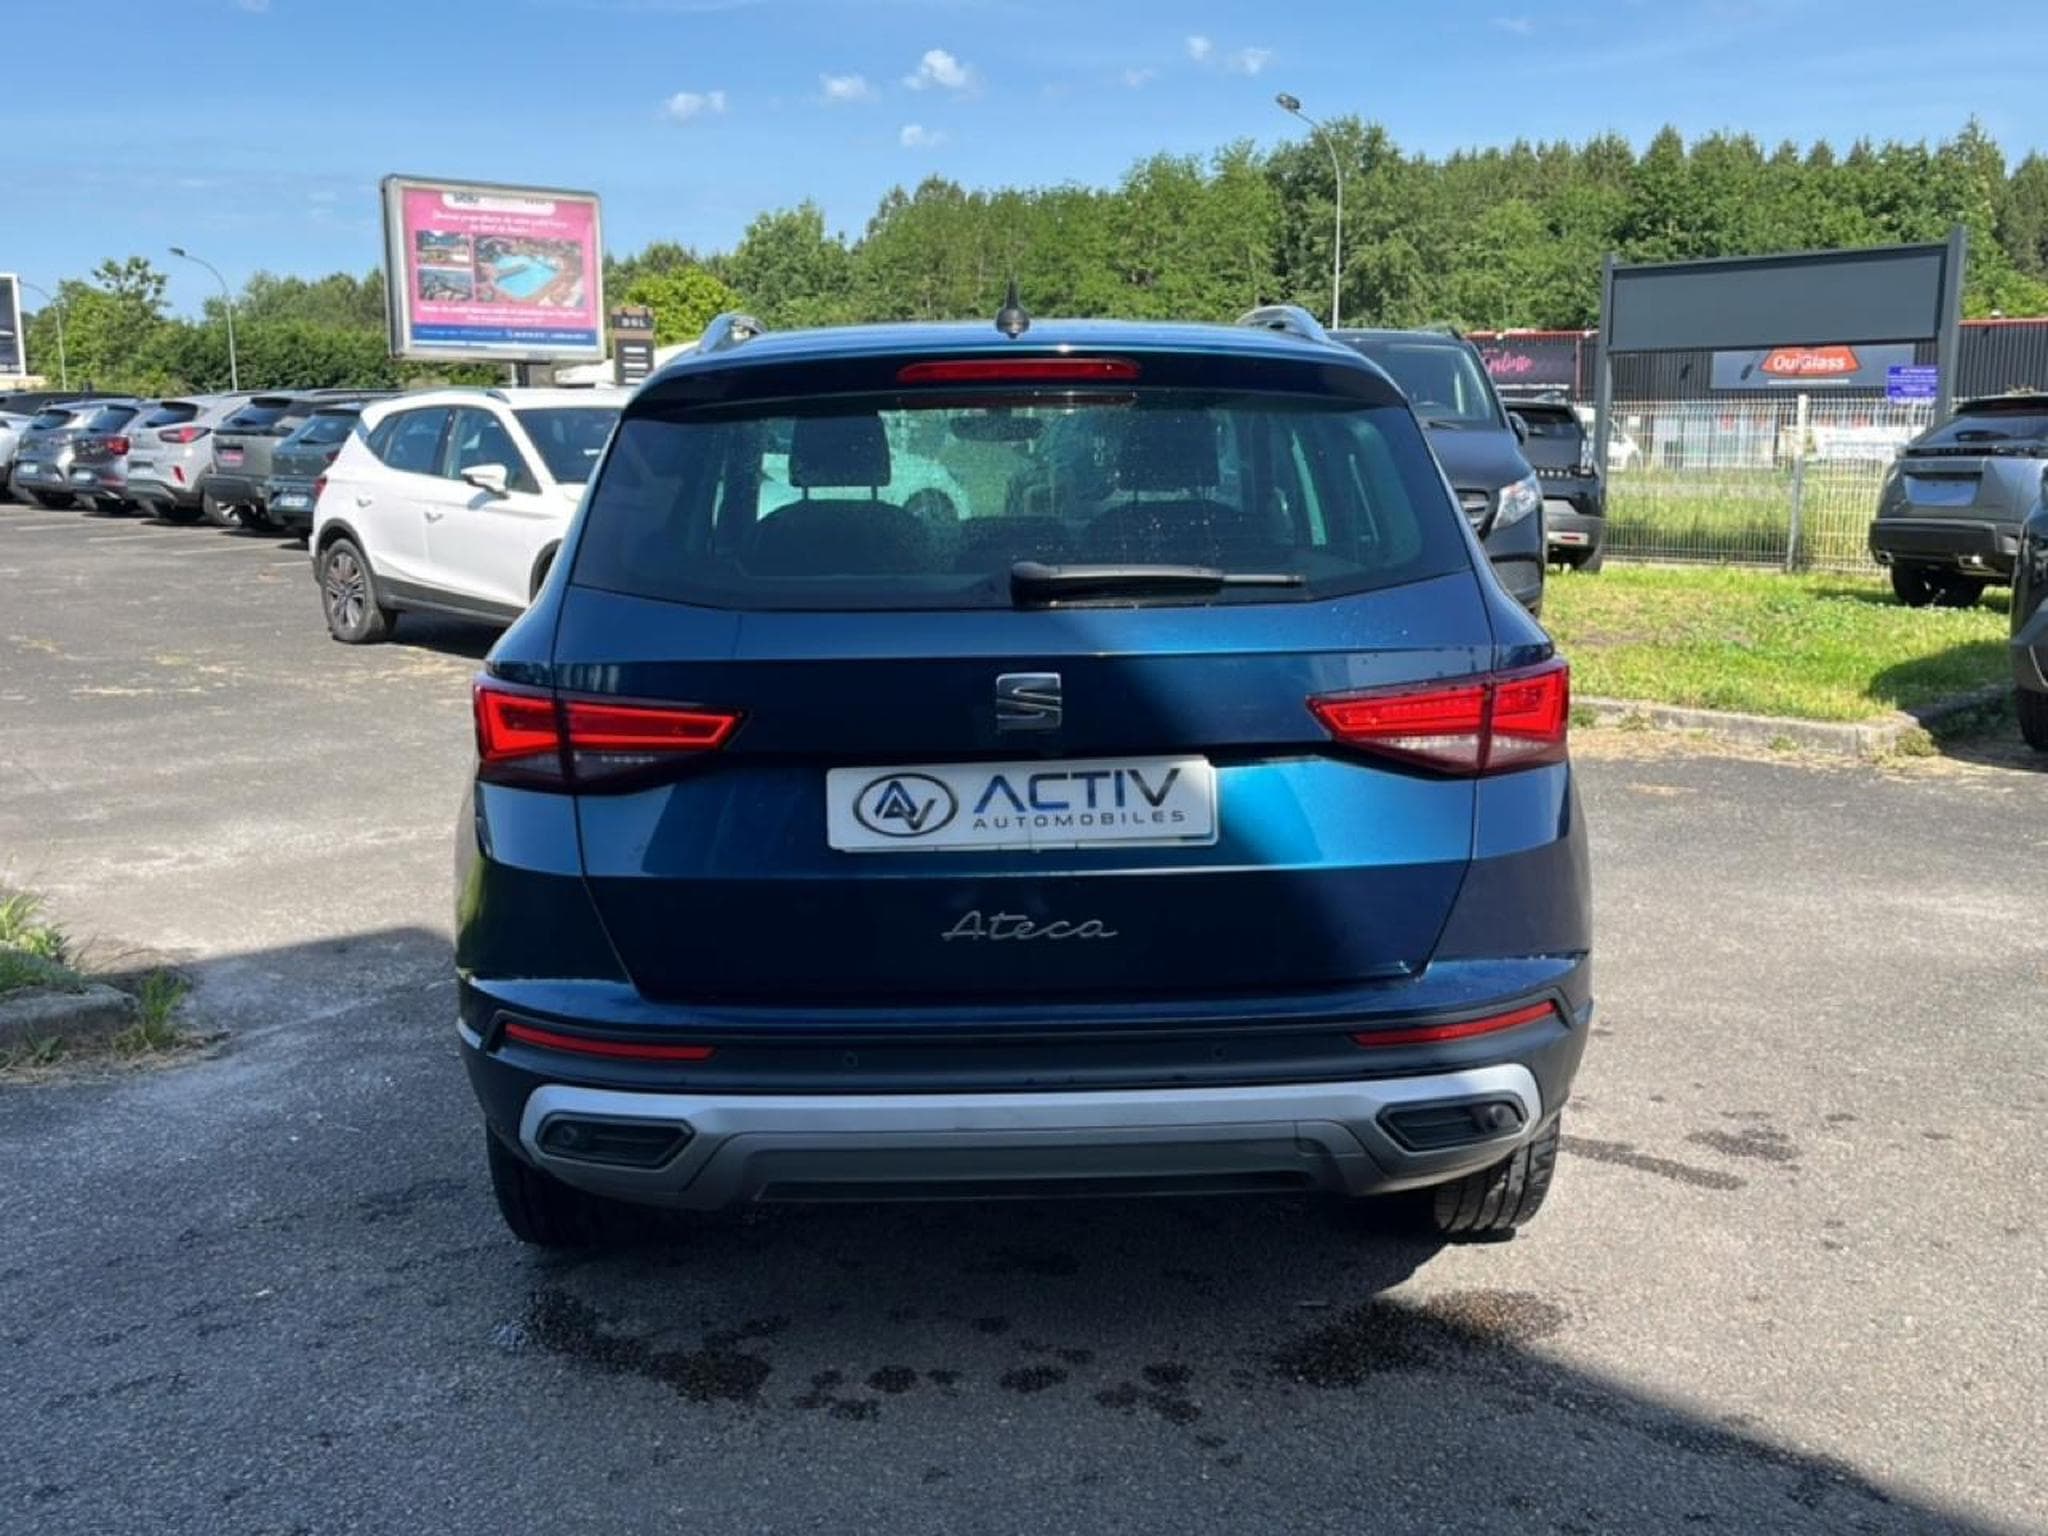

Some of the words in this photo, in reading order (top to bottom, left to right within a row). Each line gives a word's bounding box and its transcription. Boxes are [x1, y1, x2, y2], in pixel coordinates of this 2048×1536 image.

[973, 767, 1181, 813] ACTIV
[973, 810, 1186, 830] AUTOMOBILES
[942, 910, 1118, 941] Ateca
